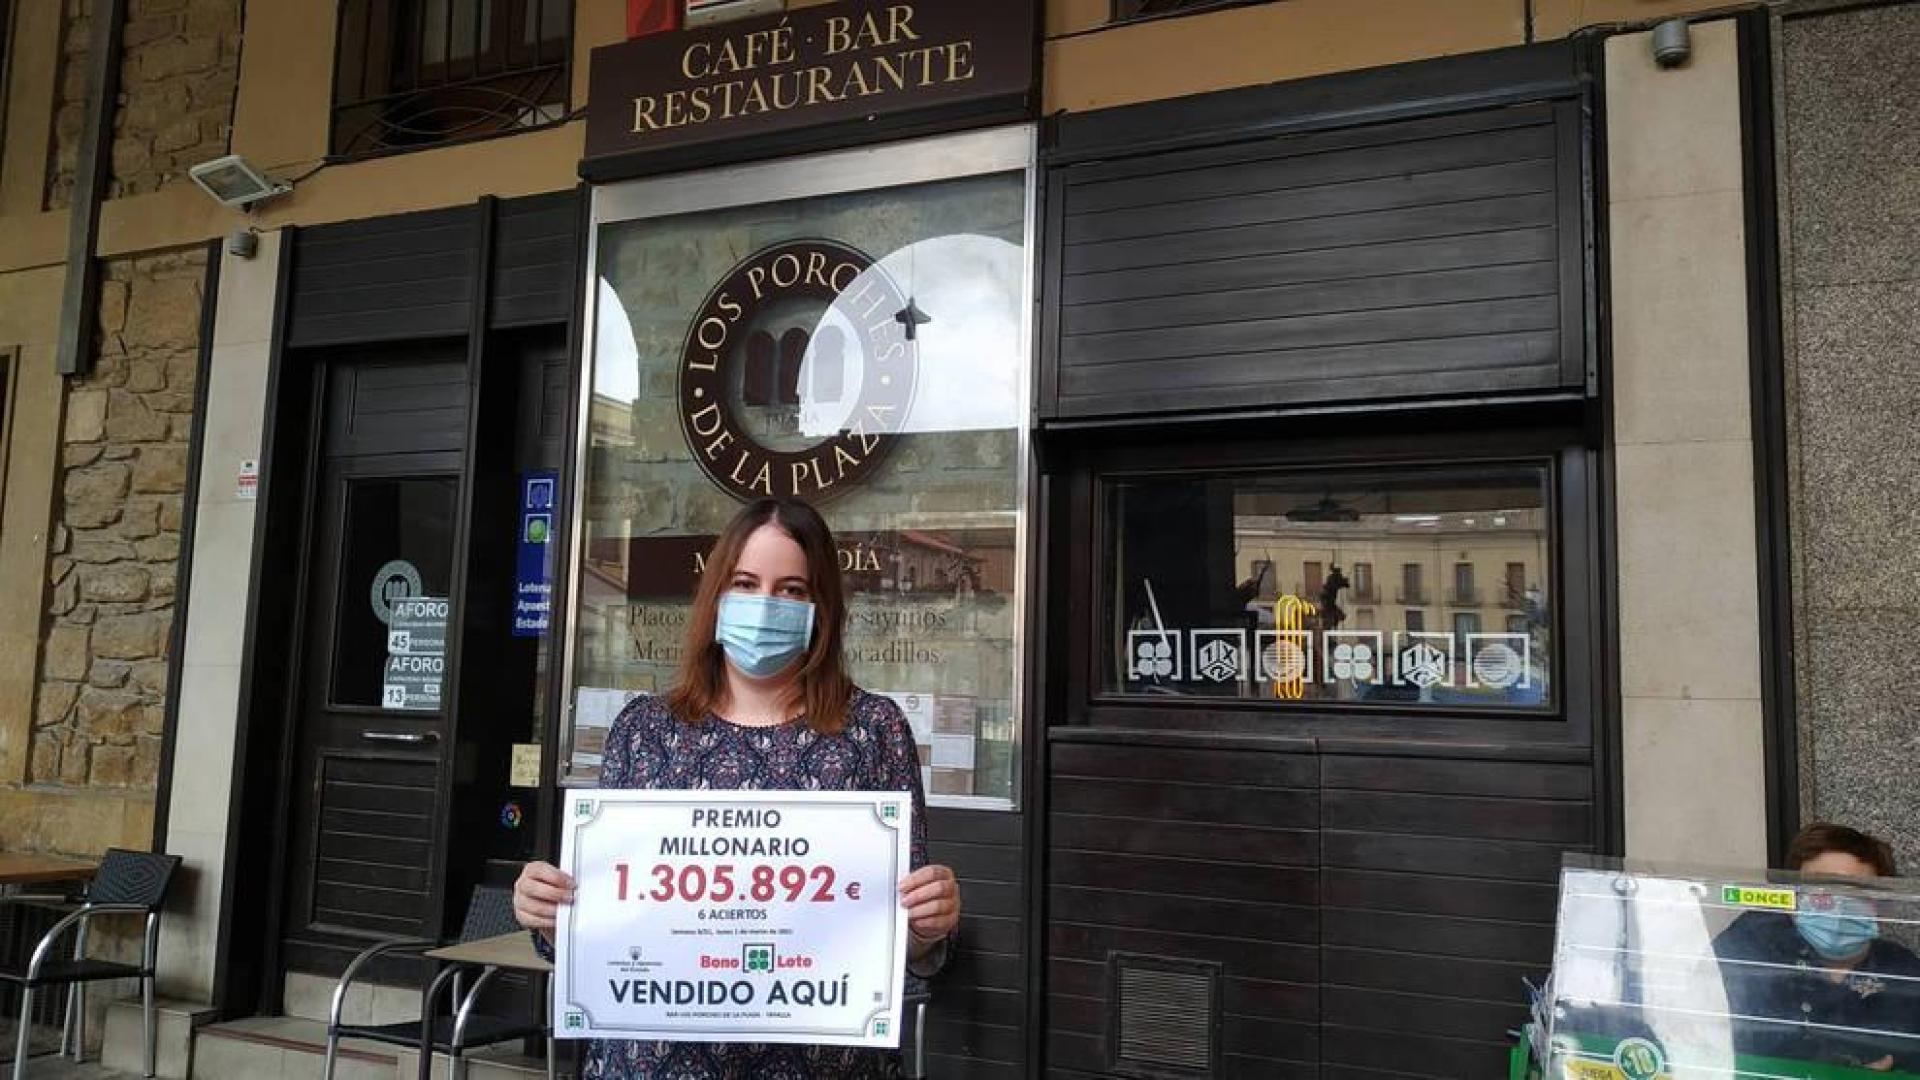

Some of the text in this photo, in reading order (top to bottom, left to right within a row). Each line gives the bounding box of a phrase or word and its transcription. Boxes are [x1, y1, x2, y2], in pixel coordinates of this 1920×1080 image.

[682, 4, 921, 80] CAFÉ BAR
[629, 41, 975, 134] RESTAURANTE
[689, 252, 904, 372] LOS PORCHES
[691, 402, 897, 495] DE LA PLAZA
[837, 542, 882, 571] DÍA
[395, 602, 449, 617] AFORO
[631, 604, 946, 634] Platos esayunos
[391, 634, 408, 649] 45
[847, 640, 947, 663] ocadillos.
[389, 656, 443, 672] AFORO
[387, 688, 403, 703] 13
[691, 809, 782, 829] PREMIO
[659, 836, 810, 857] MILLONARIO
[614, 863, 862, 903] 1.305.892 €
[1742, 890, 1790, 905] ONCE
[697, 908, 768, 921] 6 ACIERTOS
[700, 954, 812, 969] Bono Loto
[608, 973, 850, 1008] VENDIDO AQUÍ
